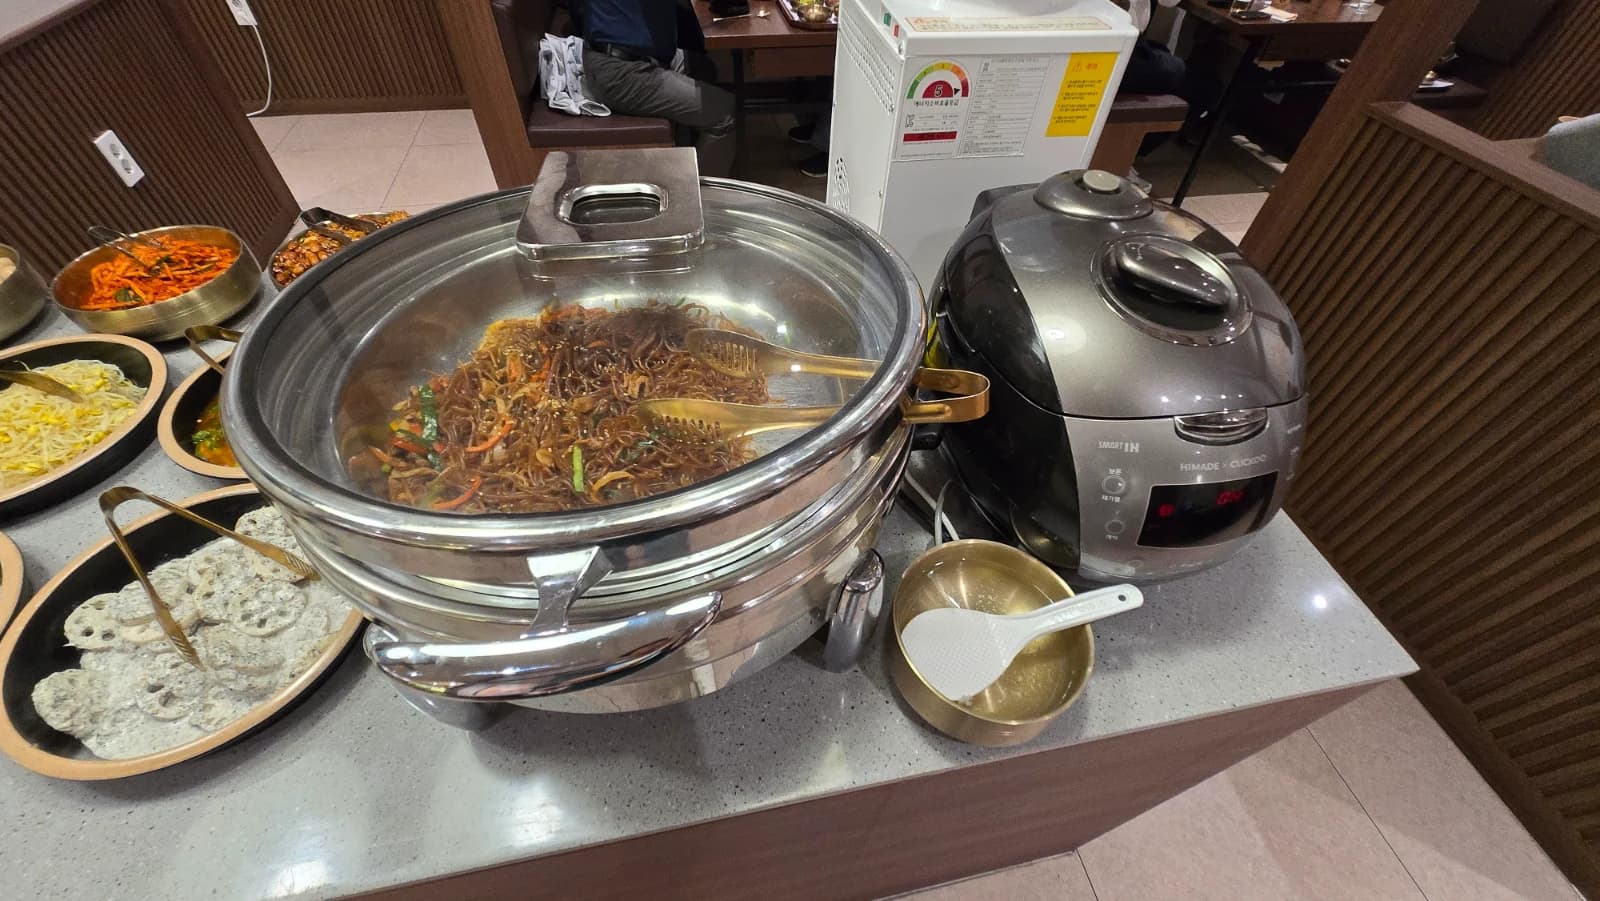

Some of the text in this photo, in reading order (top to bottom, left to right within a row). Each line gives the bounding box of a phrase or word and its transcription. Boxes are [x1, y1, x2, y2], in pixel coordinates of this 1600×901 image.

[934, 85, 944, 98] 5
[1124, 442, 1139, 453] IH
[1180, 463, 1221, 471] HIMADE
